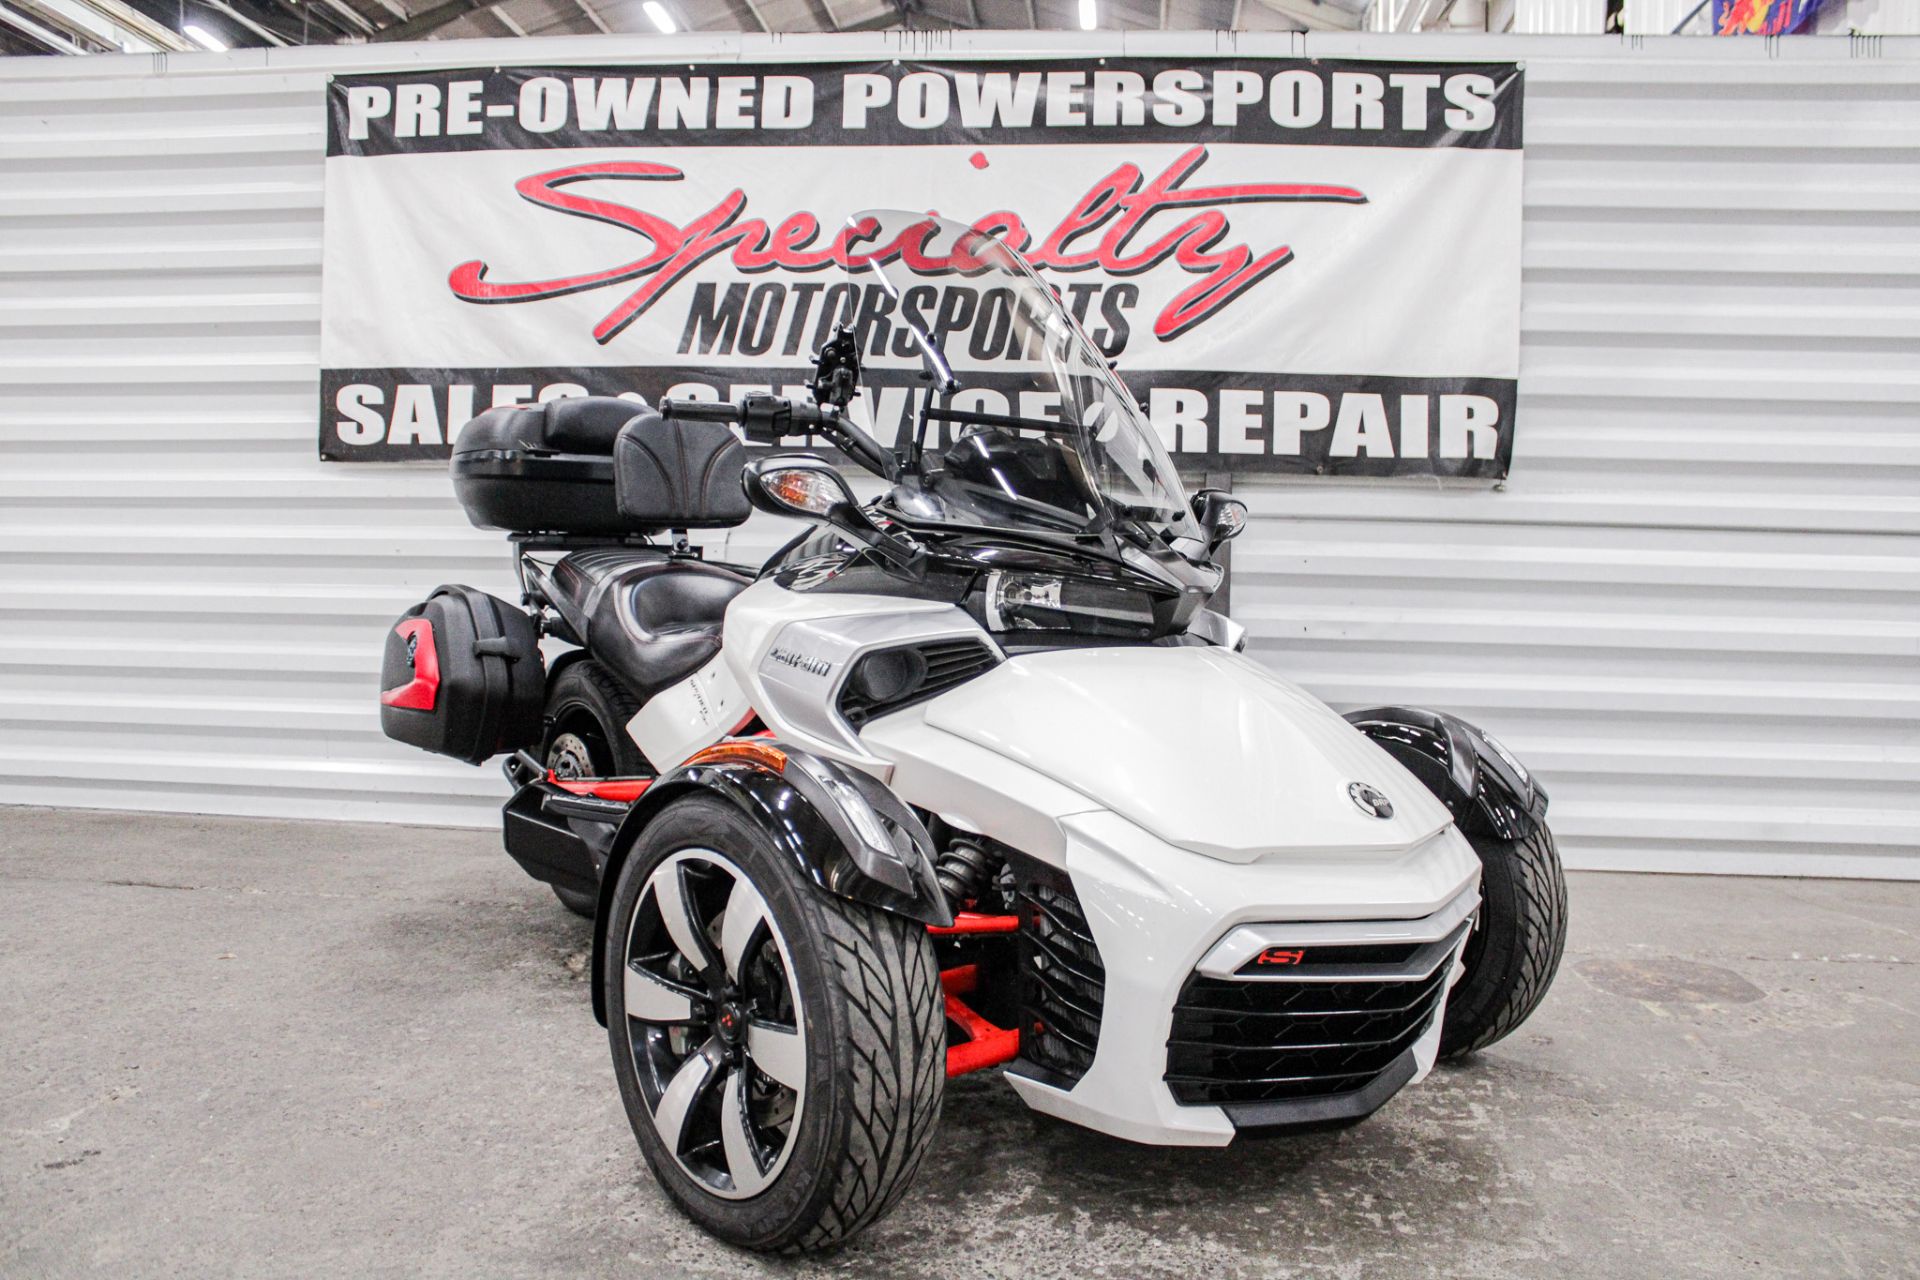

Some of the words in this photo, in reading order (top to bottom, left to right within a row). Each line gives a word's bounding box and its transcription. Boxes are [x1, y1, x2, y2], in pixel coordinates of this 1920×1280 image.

[347, 75, 815, 139] PRE-OWNED
[842, 69, 1497, 132] POWERSPORTS
[448, 144, 1369, 345] Specialty
[677, 281, 1140, 361] MOTORSPORTS
[336, 383, 590, 446] SAL
[1138, 388, 1502, 460] REPAIR
